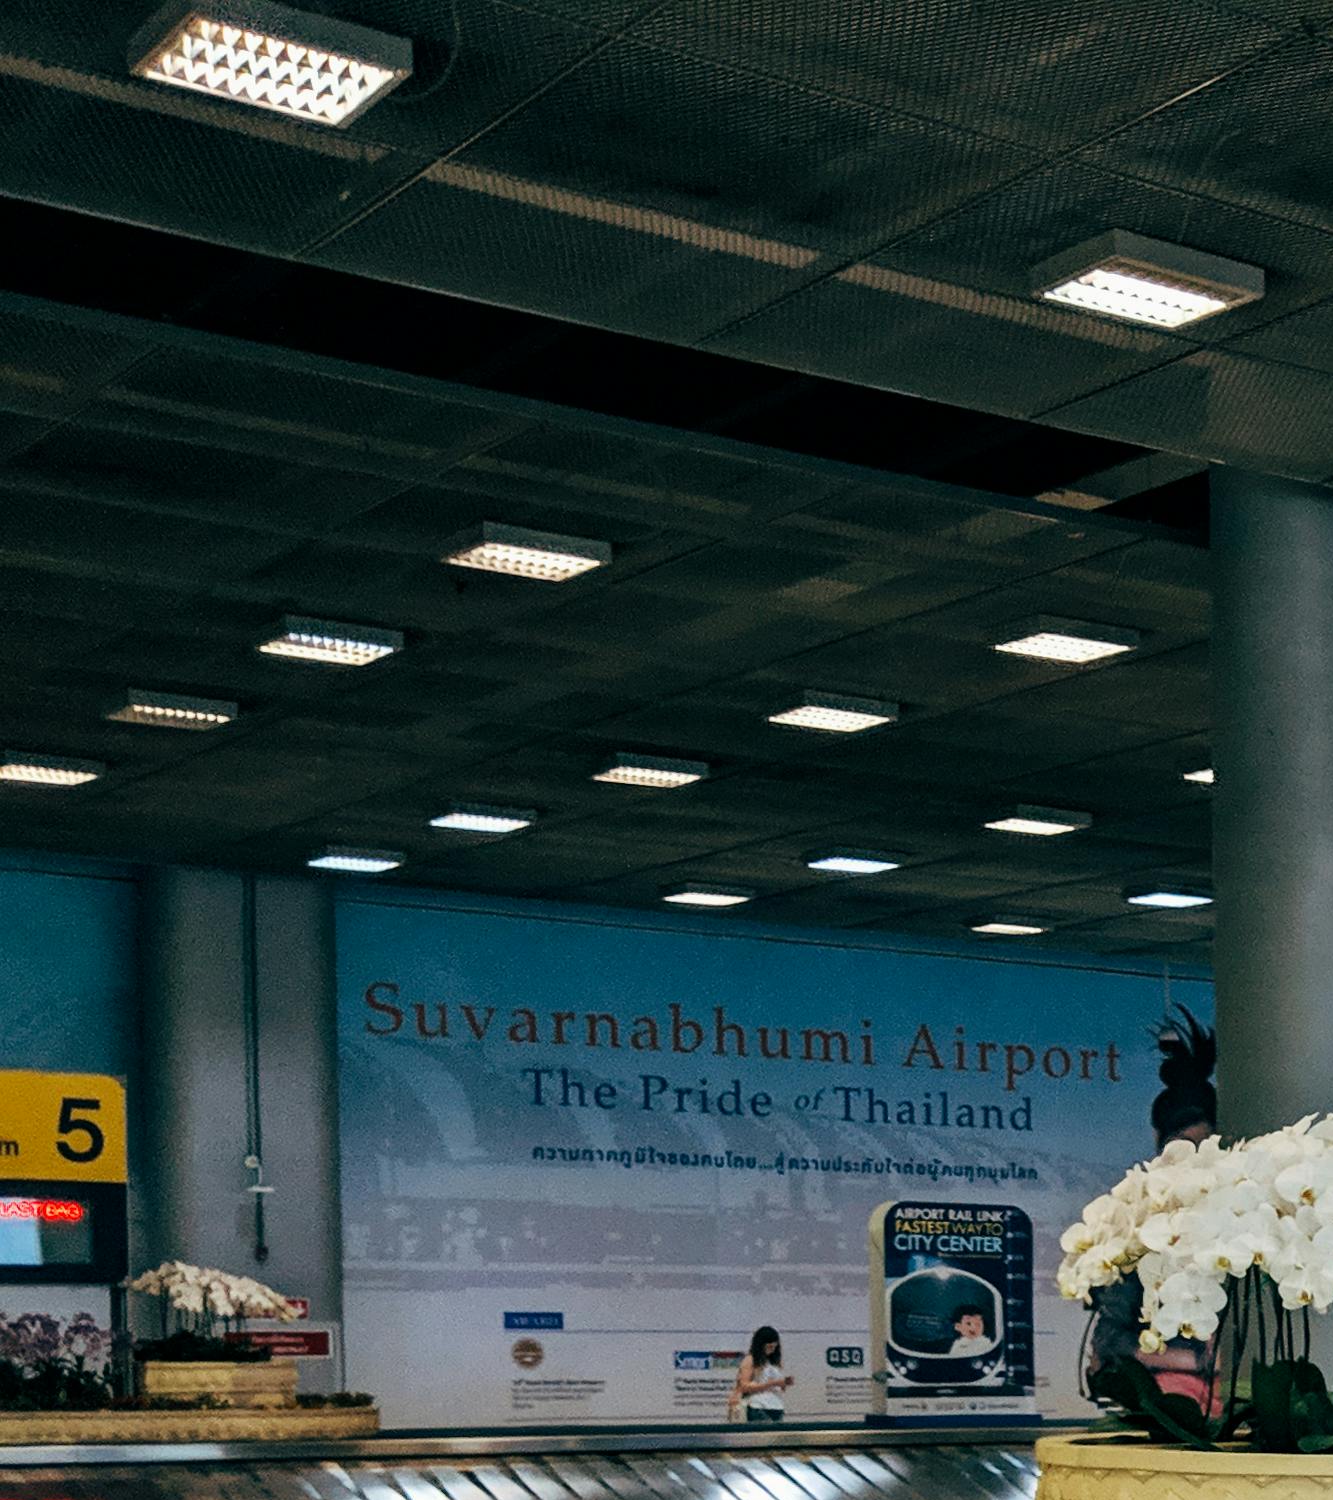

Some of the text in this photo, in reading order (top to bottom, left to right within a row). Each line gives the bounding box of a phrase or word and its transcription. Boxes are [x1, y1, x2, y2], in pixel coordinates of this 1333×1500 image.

[364, 981, 1121, 1092] Suvarnabhumi Airport
[521, 1064, 1033, 1131] The Pride of Thailand
[56, 1096, 105, 1163] 5
[894, 1208, 1004, 1223] AIRPORT RAIL LINK
[895, 1221, 1004, 1235] FASTEST WAY TO
[894, 1234, 1003, 1253] CITY CENTER
